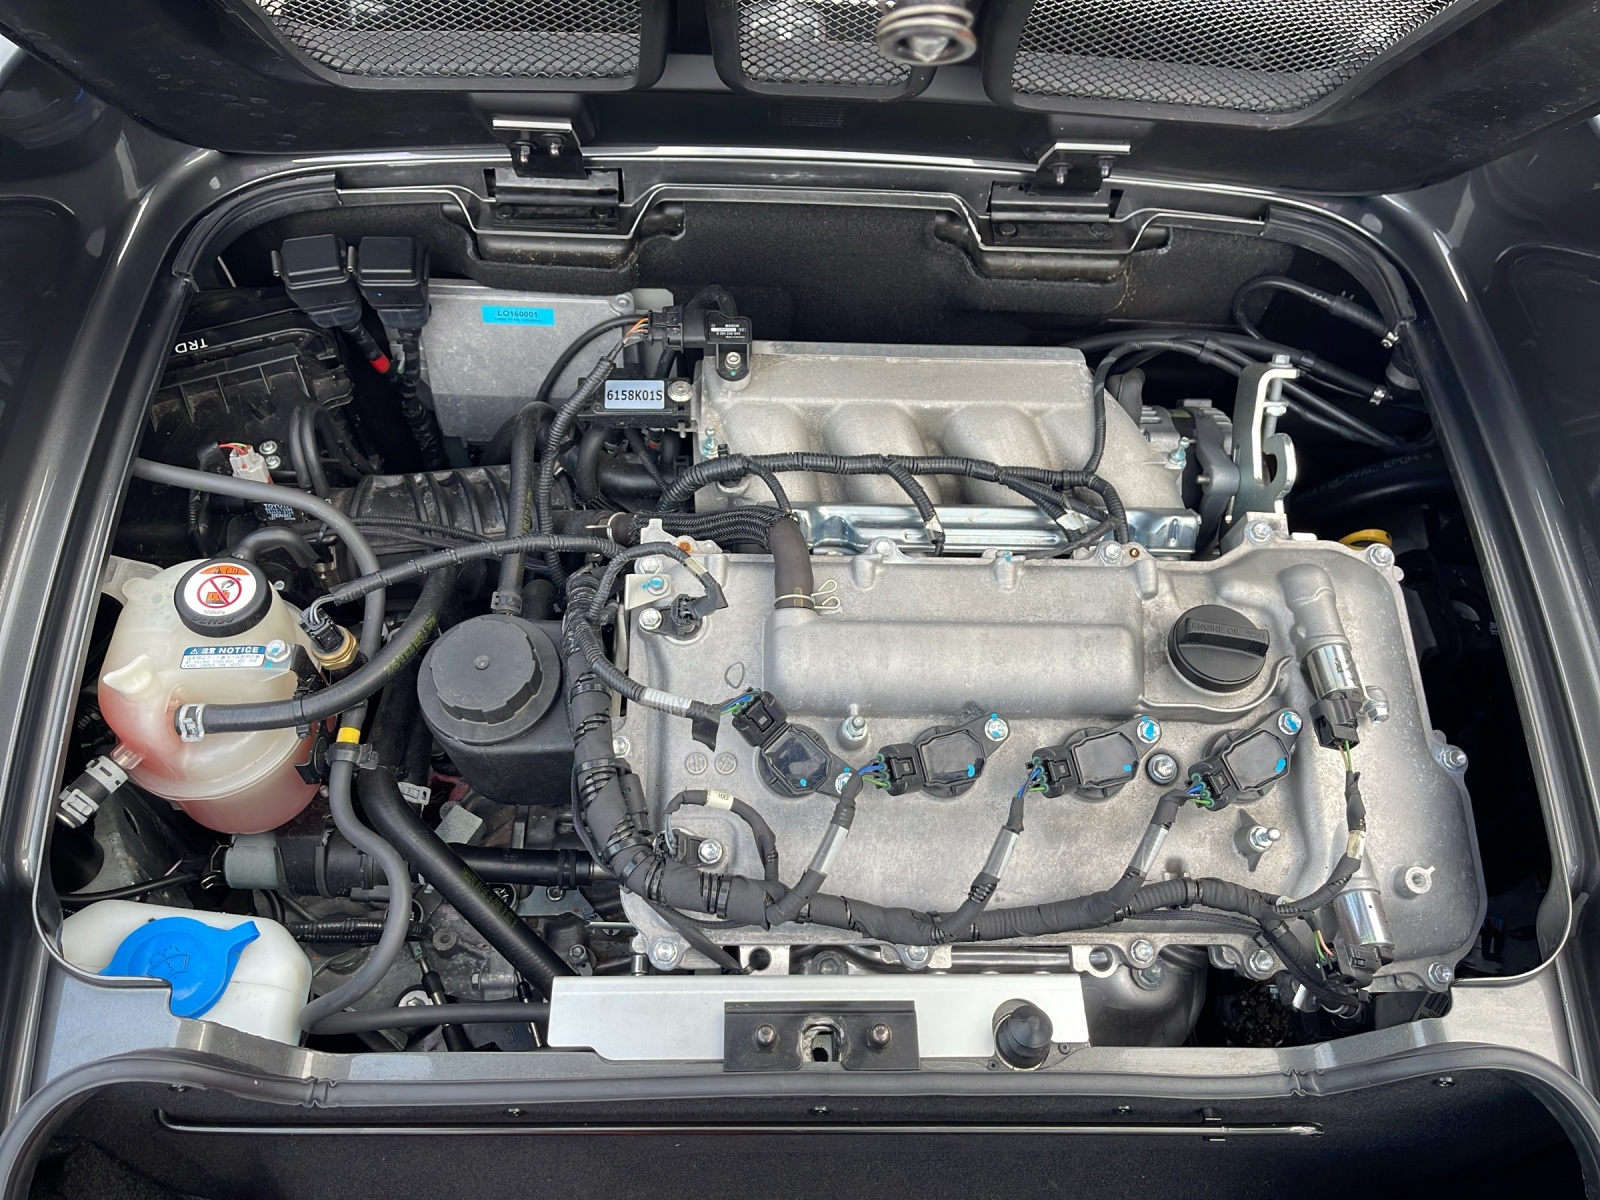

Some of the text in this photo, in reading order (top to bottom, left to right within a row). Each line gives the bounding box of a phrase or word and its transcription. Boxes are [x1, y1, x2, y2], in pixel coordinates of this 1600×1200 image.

[497, 309, 538, 318] LO160001
[174, 337, 209, 354] TRD
[607, 389, 663, 401] 6158K01S
[190, 615, 235, 625] DENSO
[1191, 622, 1238, 635] ENGINE OIL
[218, 646, 260, 654] NOTICE
